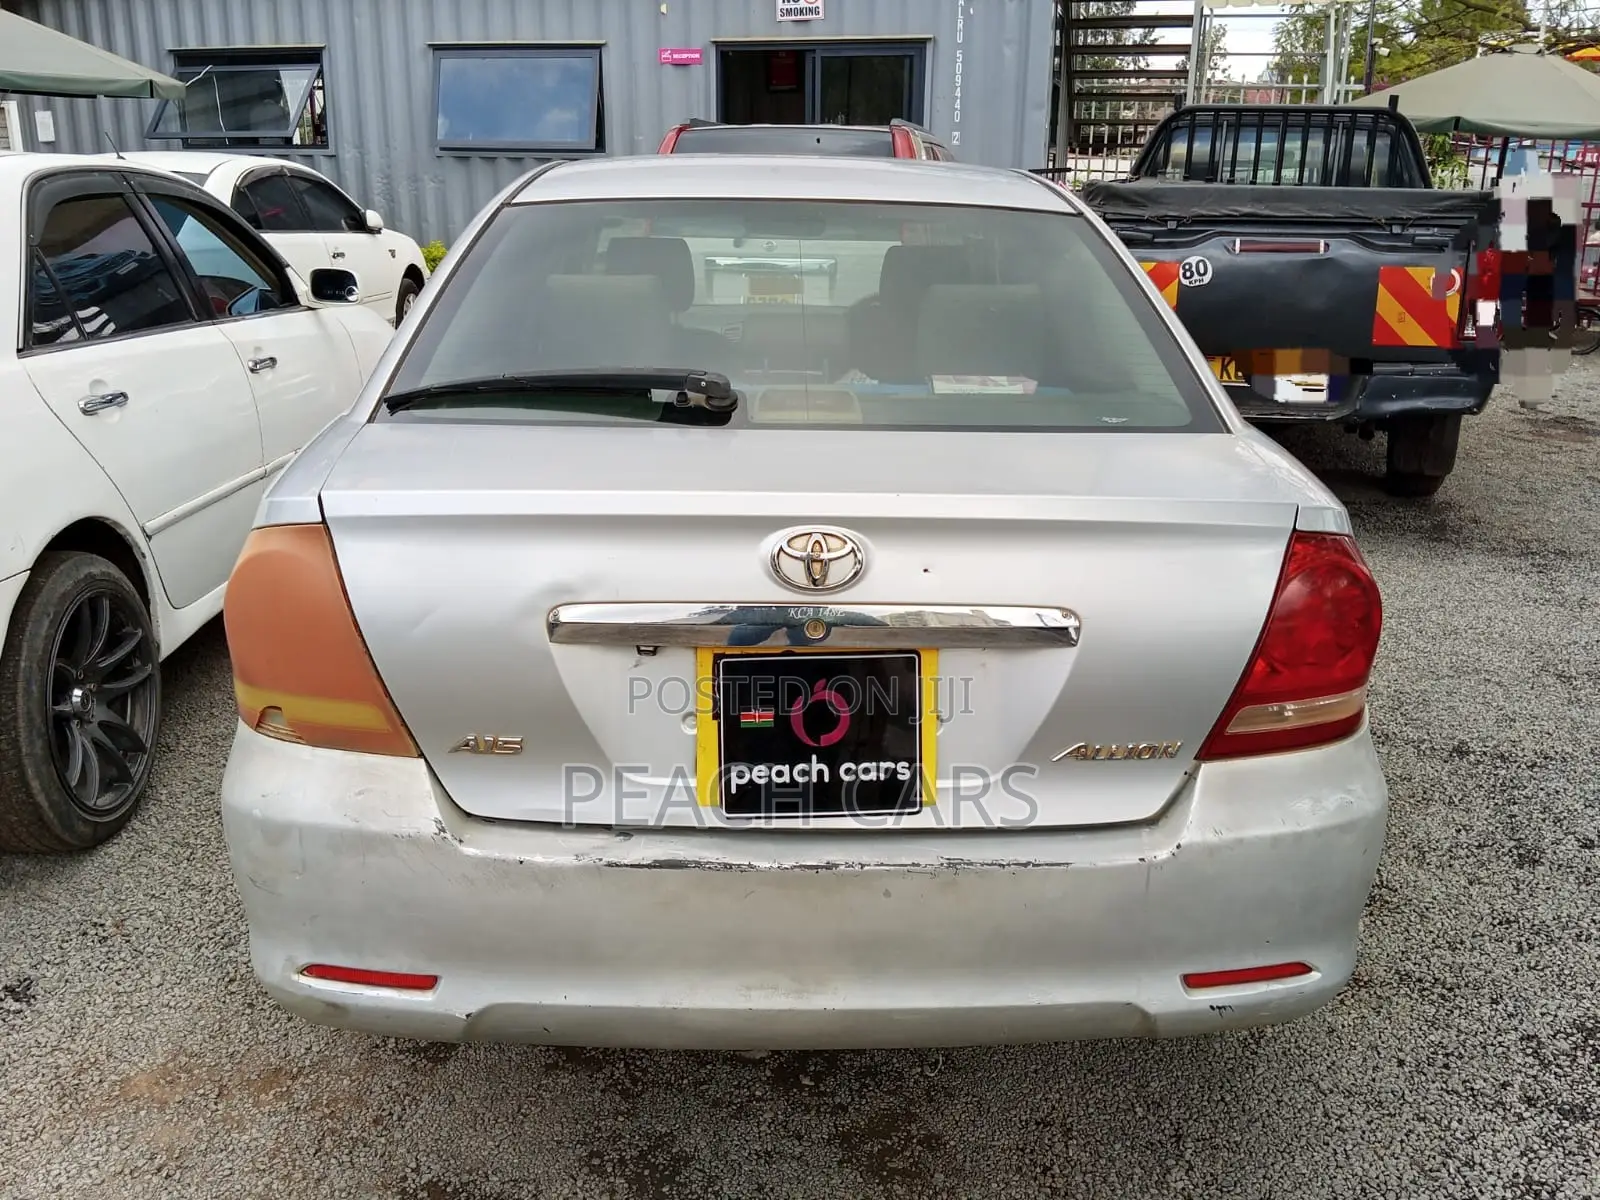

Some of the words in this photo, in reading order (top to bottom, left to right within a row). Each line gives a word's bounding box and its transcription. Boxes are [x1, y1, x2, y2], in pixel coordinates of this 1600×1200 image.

[779, 5, 820, 18] SMOKING
[954, 50, 963, 122] 509440
[952, 132, 960, 145] 2
[1181, 259, 1209, 280] 80
[788, 606, 814, 619] KCA
[1051, 741, 1184, 762] ALLION
[730, 754, 830, 794] peach
[841, 758, 911, 783] cars
